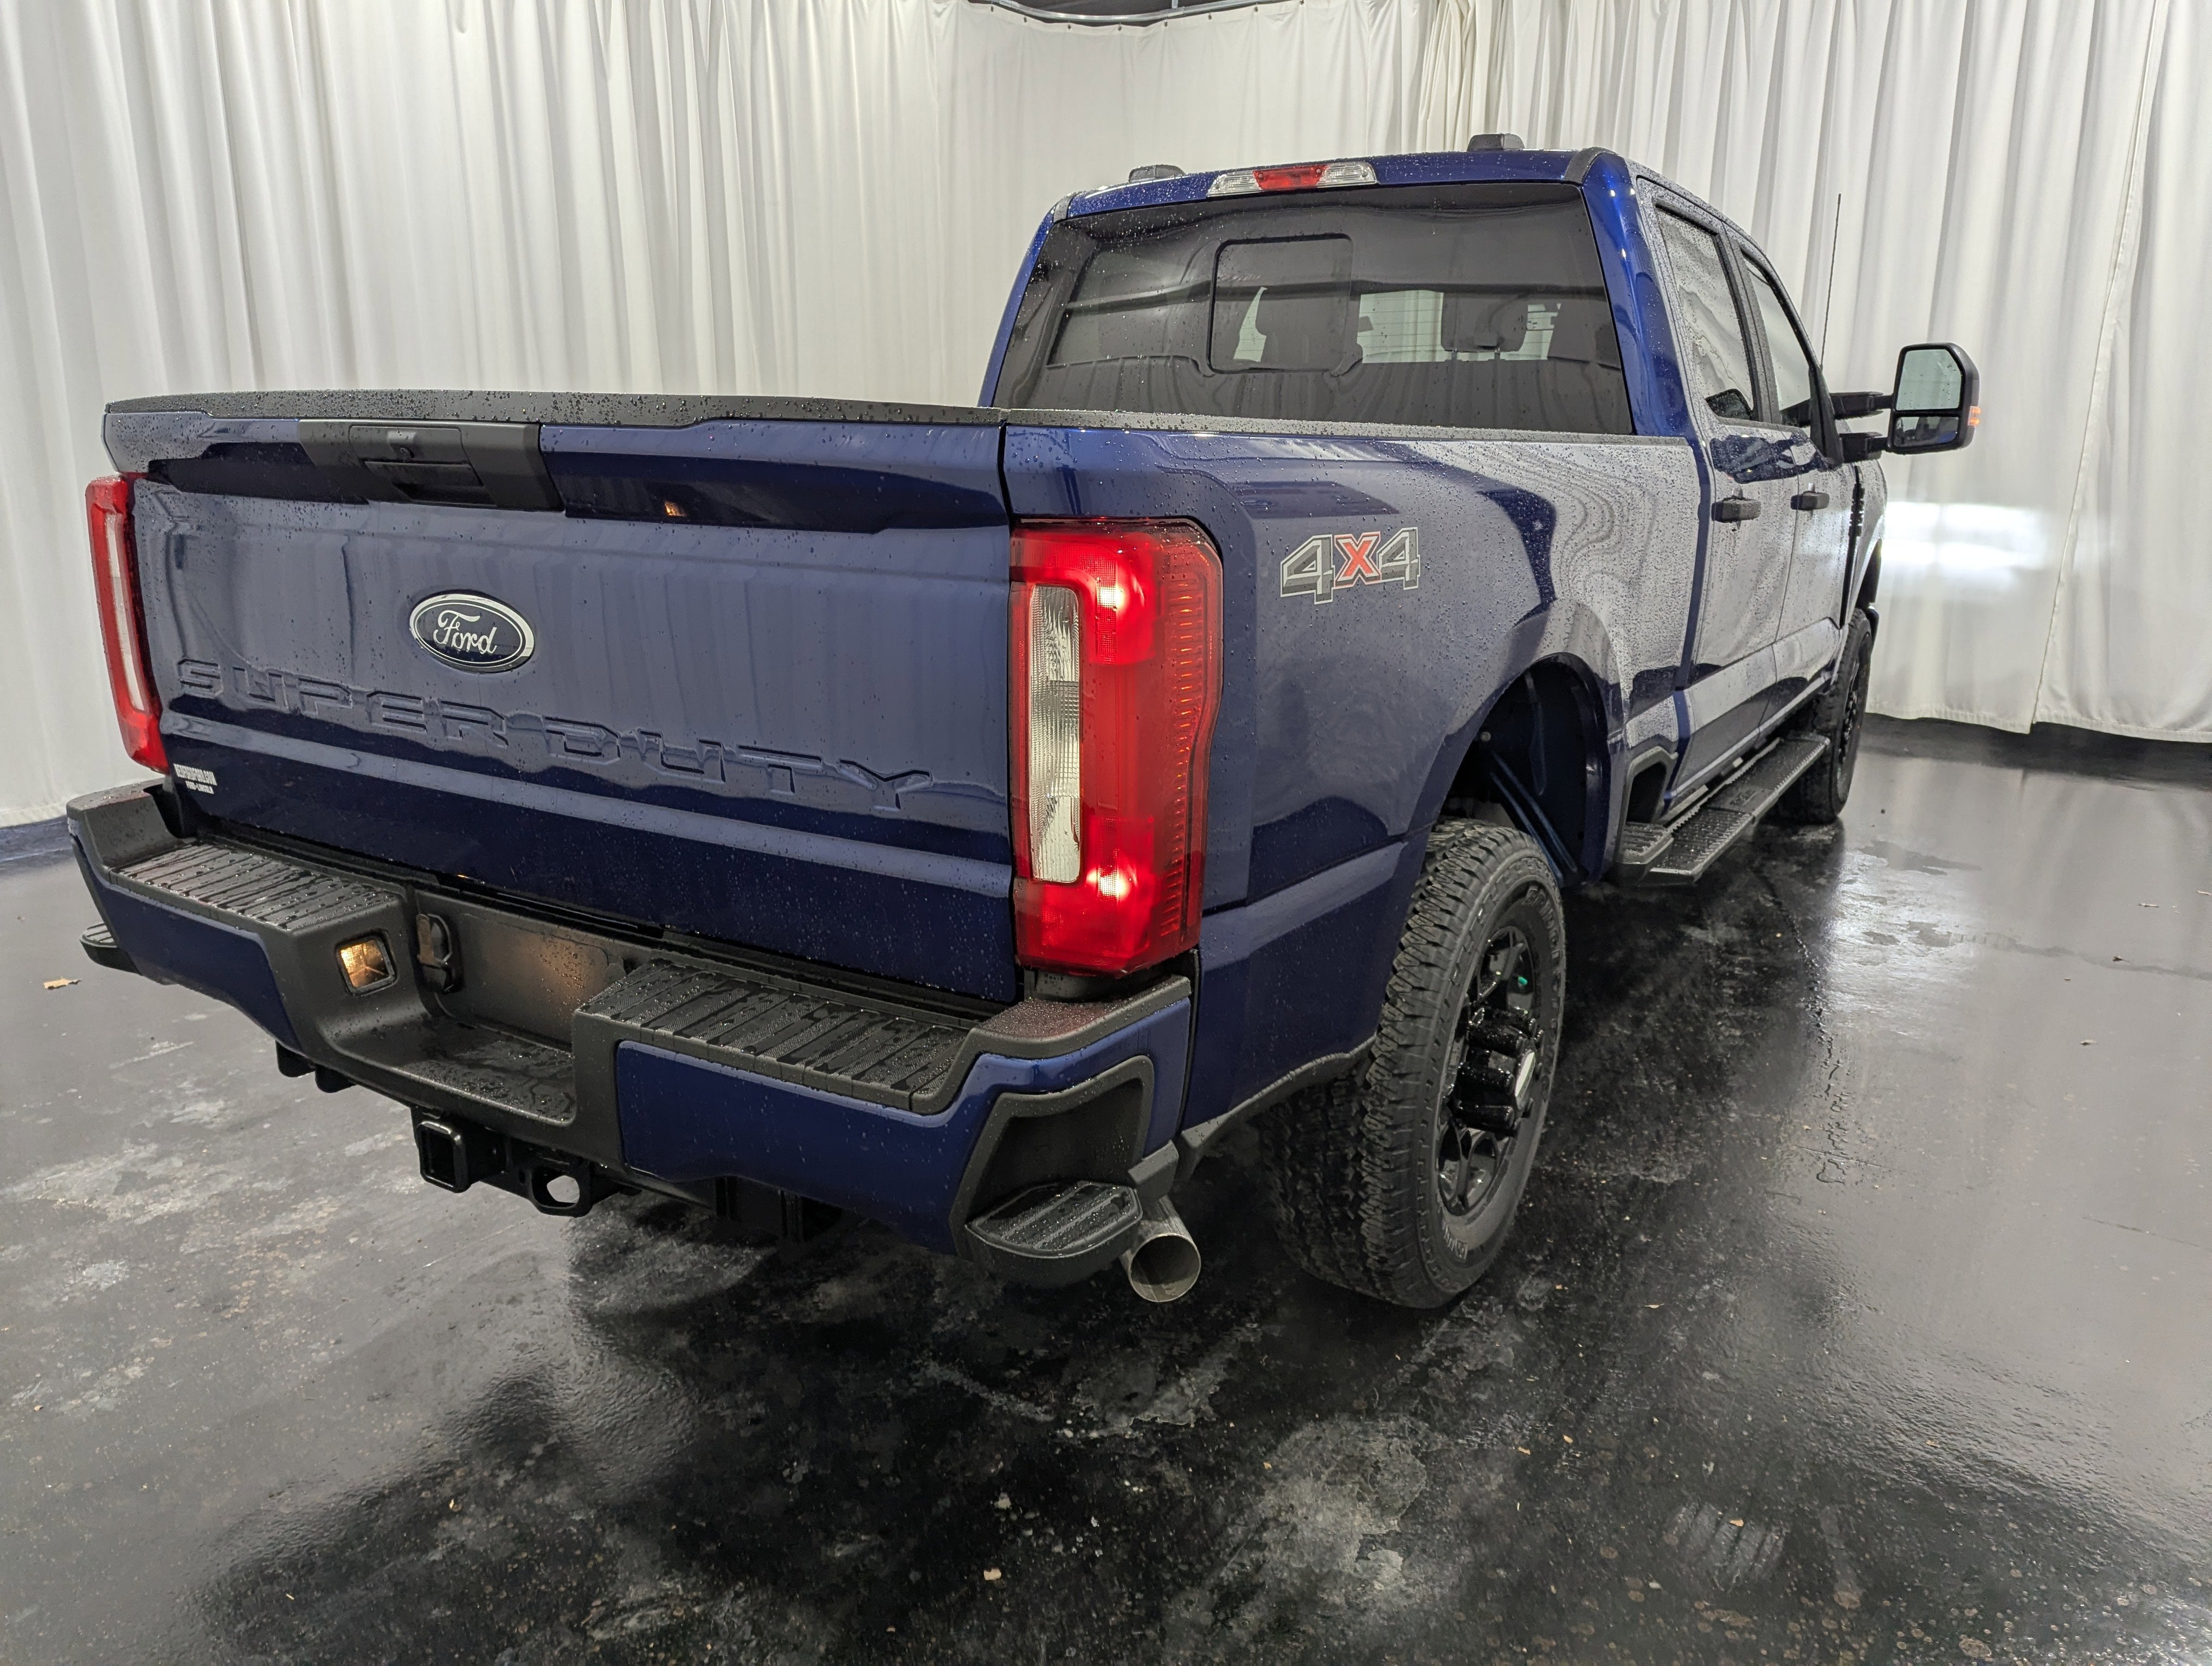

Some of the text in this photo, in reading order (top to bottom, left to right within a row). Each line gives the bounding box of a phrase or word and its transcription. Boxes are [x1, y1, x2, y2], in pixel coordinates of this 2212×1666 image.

[433, 610, 497, 655] Ford
[178, 658, 933, 811] SUPER DUTY
